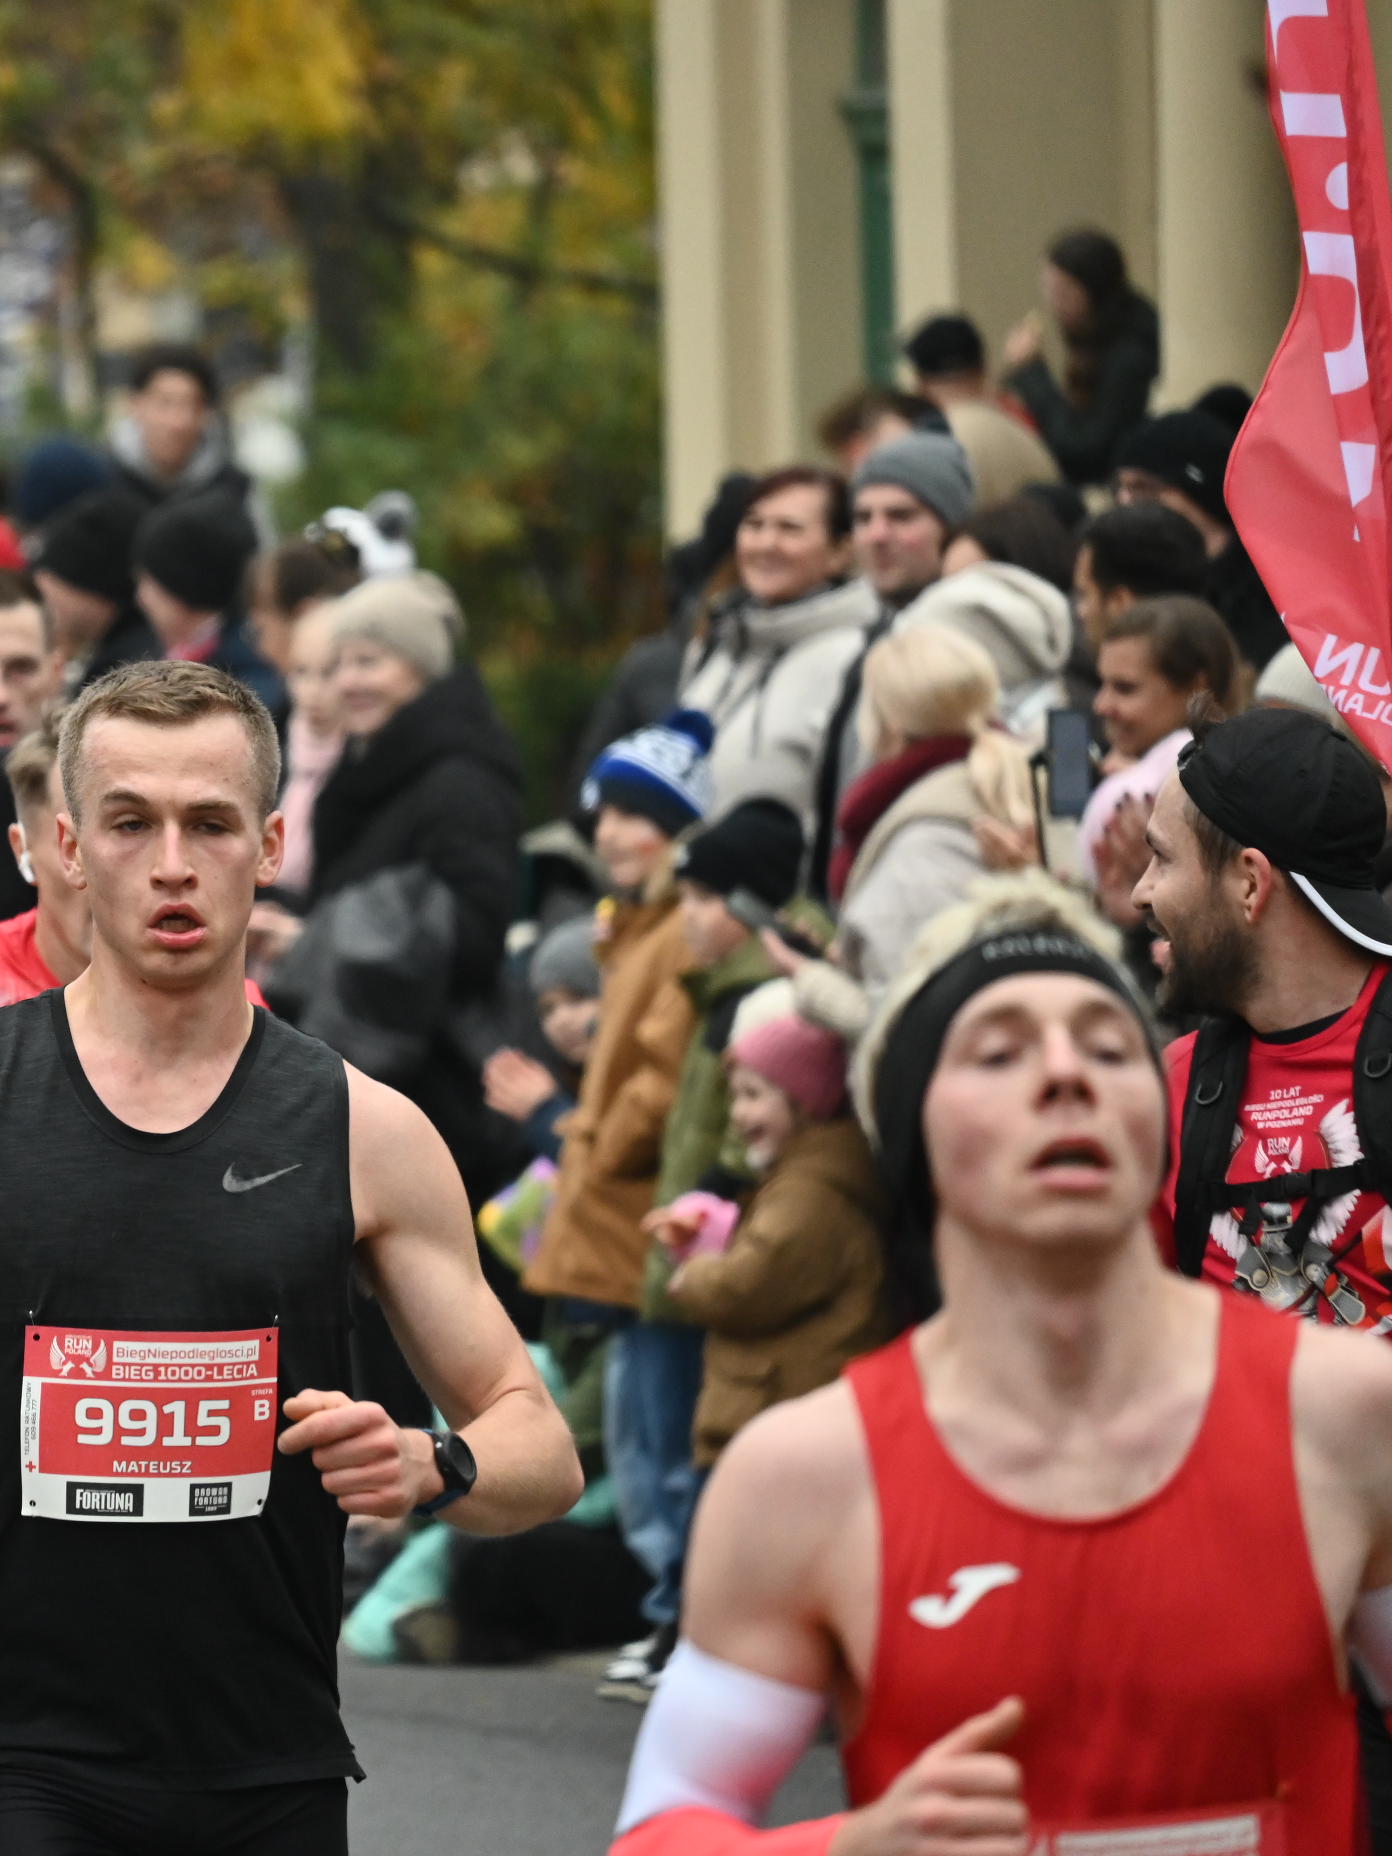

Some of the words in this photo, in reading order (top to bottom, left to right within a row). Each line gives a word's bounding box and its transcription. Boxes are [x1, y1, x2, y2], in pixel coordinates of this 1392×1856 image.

[1269, 1089, 1282, 1100] 10
[1283, 1086, 1302, 1098] LAT
[65, 1338, 92, 1349] RUN
[115, 1345, 257, 1361] BiegNiepodleglosci.pl
[111, 1365, 155, 1380] BIEG
[157, 1364, 258, 1381] 1000-LECIA
[254, 1400, 270, 1420] B
[74, 1397, 231, 1447] 9915
[112, 1460, 192, 1473] MATEUSZ
[75, 1488, 134, 1512] FORTUNA
